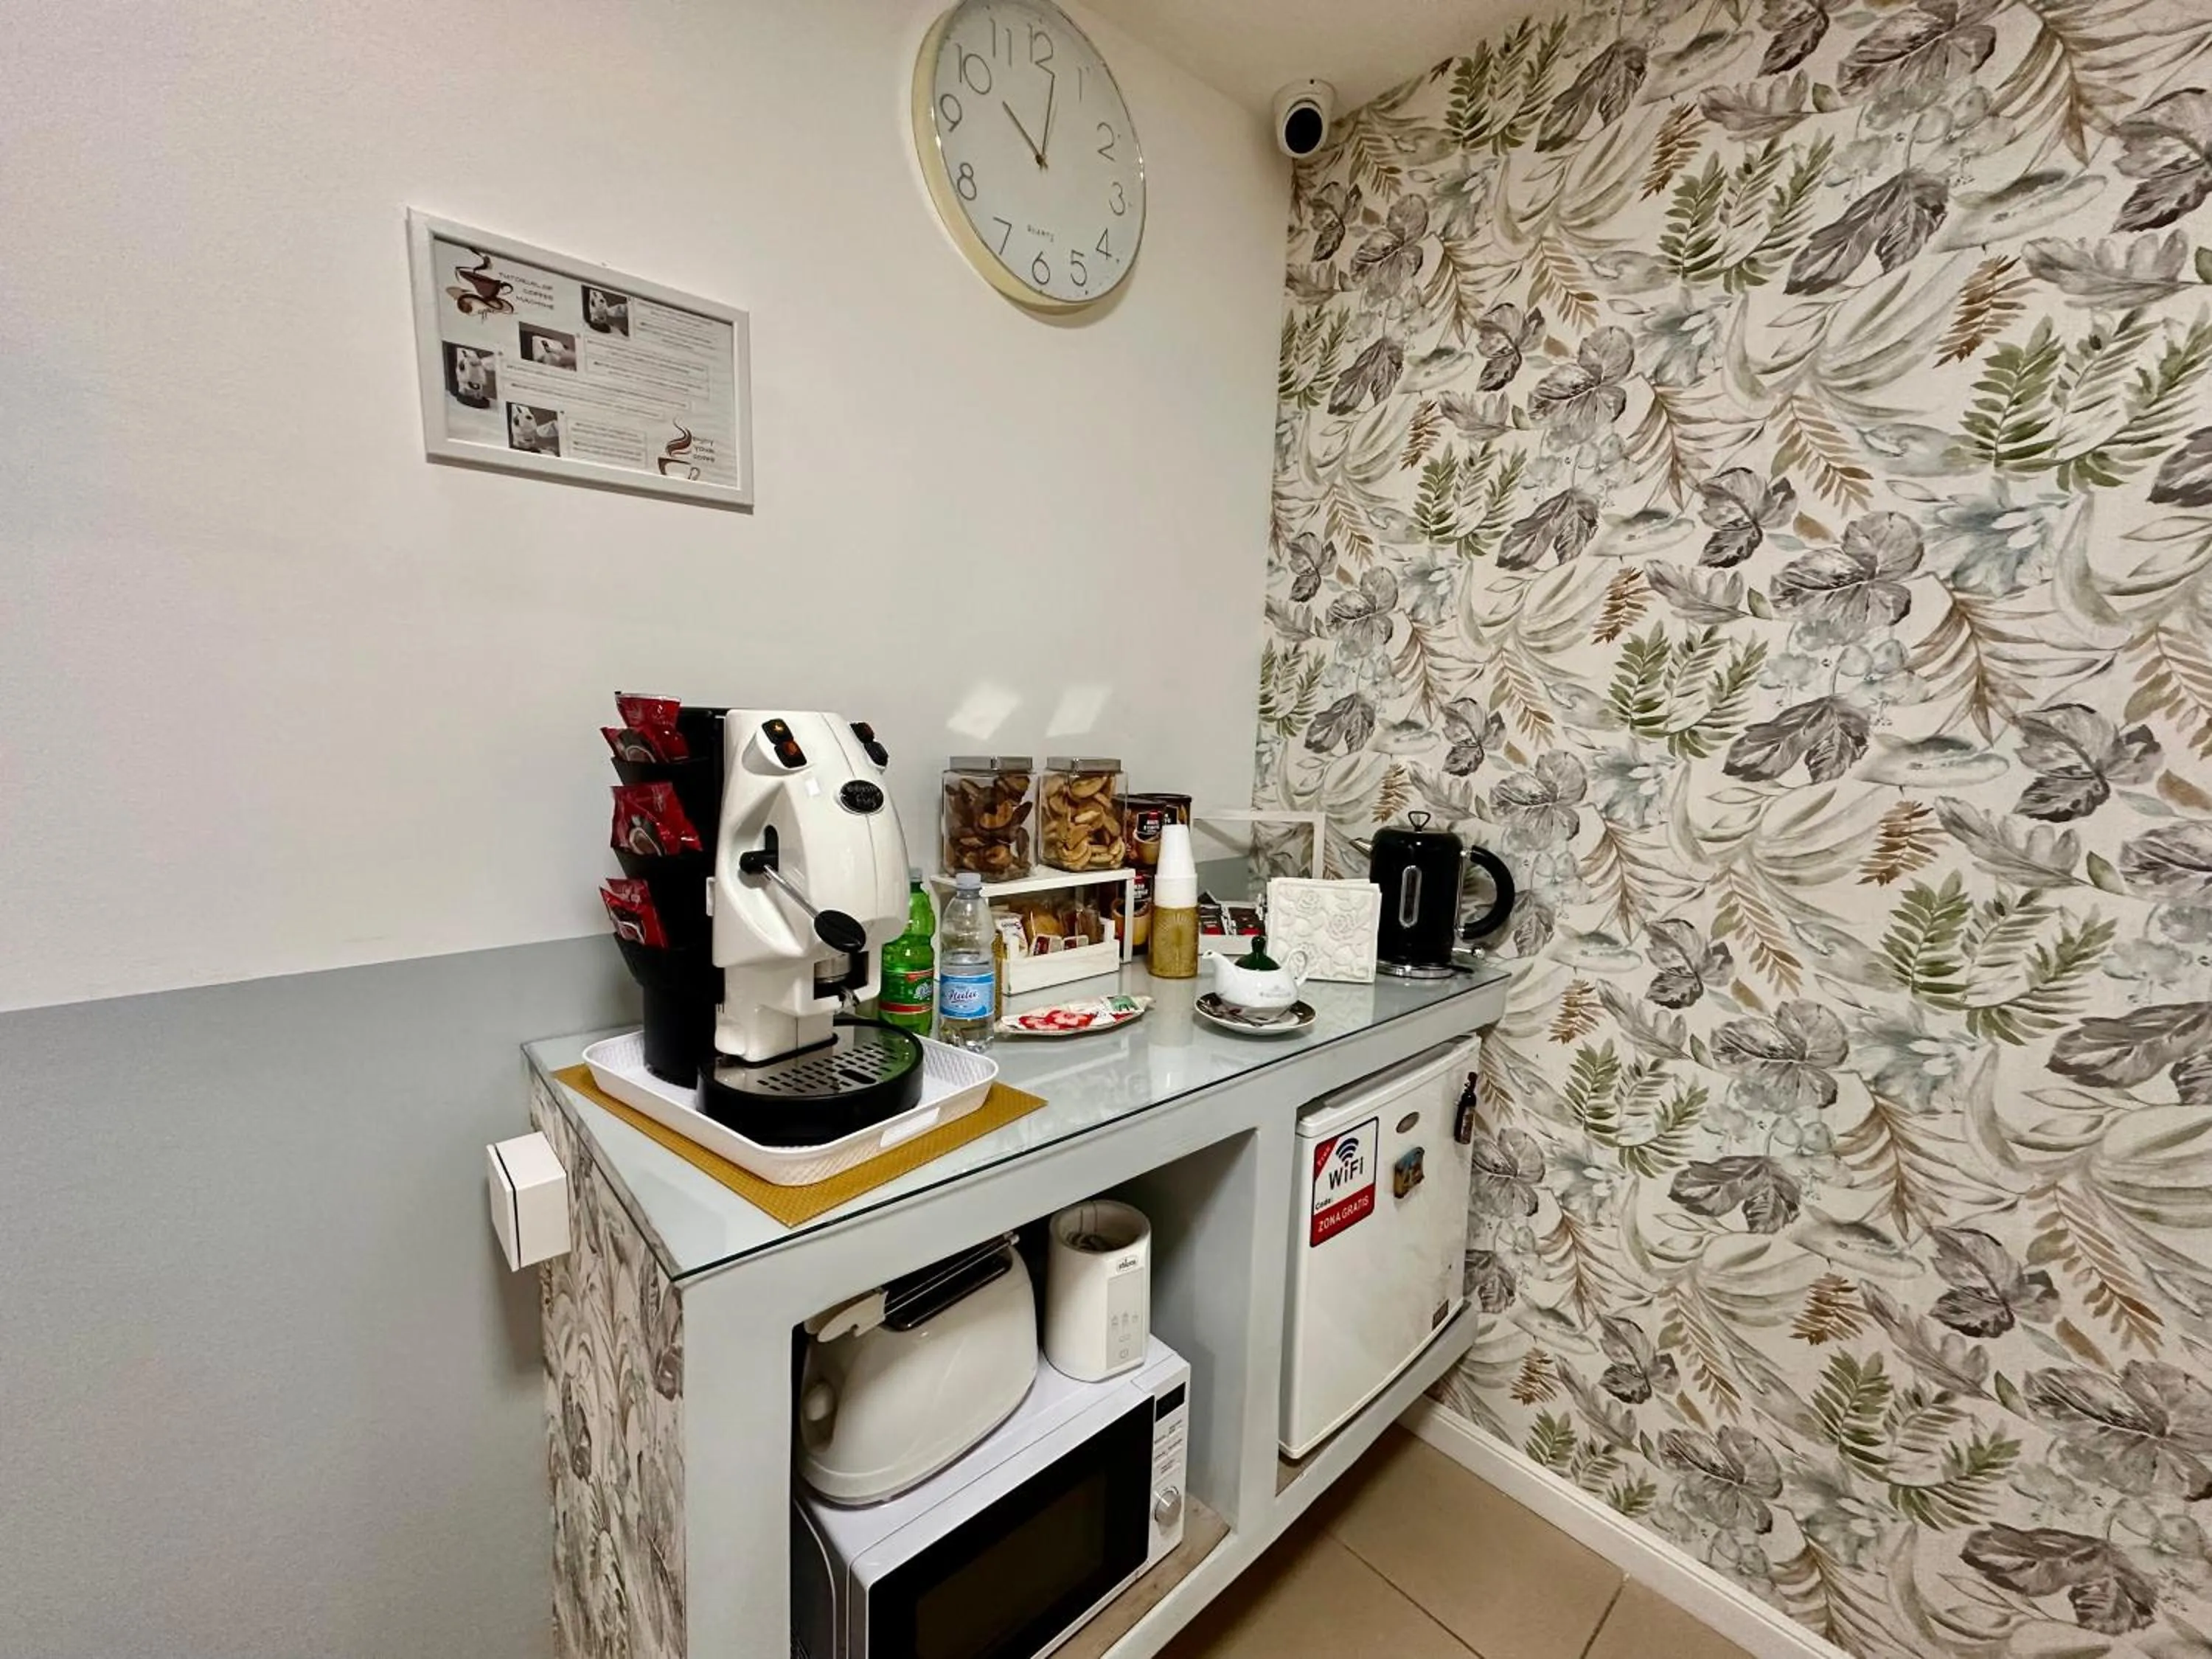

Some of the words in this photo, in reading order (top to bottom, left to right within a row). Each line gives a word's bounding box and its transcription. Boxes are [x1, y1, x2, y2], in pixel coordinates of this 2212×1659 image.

[989, 16, 1012, 68] 11
[1027, 22, 1054, 76] 12
[955, 42, 992, 95] 10
[939, 93, 963, 133] 9
[1096, 121, 1116, 162] 2
[957, 161, 978, 201] 8
[1108, 181, 1126, 216] 3
[992, 216, 1013, 256] 7
[1096, 227, 1113, 260] 4
[1032, 250, 1051, 285] 6
[1070, 248, 1088, 288] 5
[1317, 1210, 1341, 1234] ZONA
[1340, 1194, 1370, 1220] GRATIS
